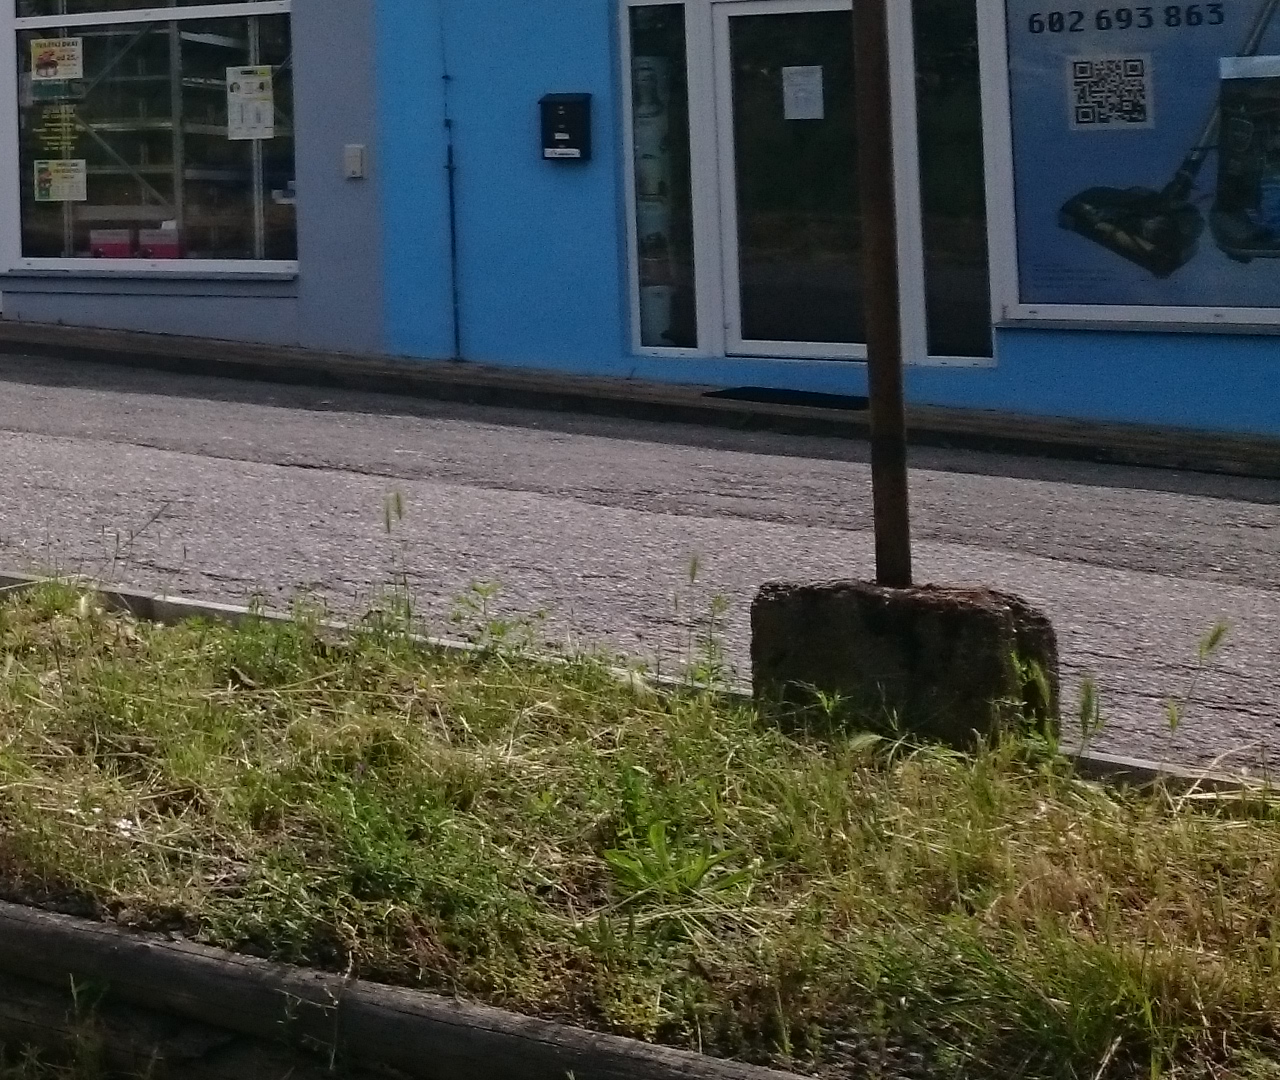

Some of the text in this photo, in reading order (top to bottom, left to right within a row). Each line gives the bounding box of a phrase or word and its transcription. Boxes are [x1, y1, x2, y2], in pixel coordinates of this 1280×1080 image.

[1028, 3, 1225, 34] 602 693 863
